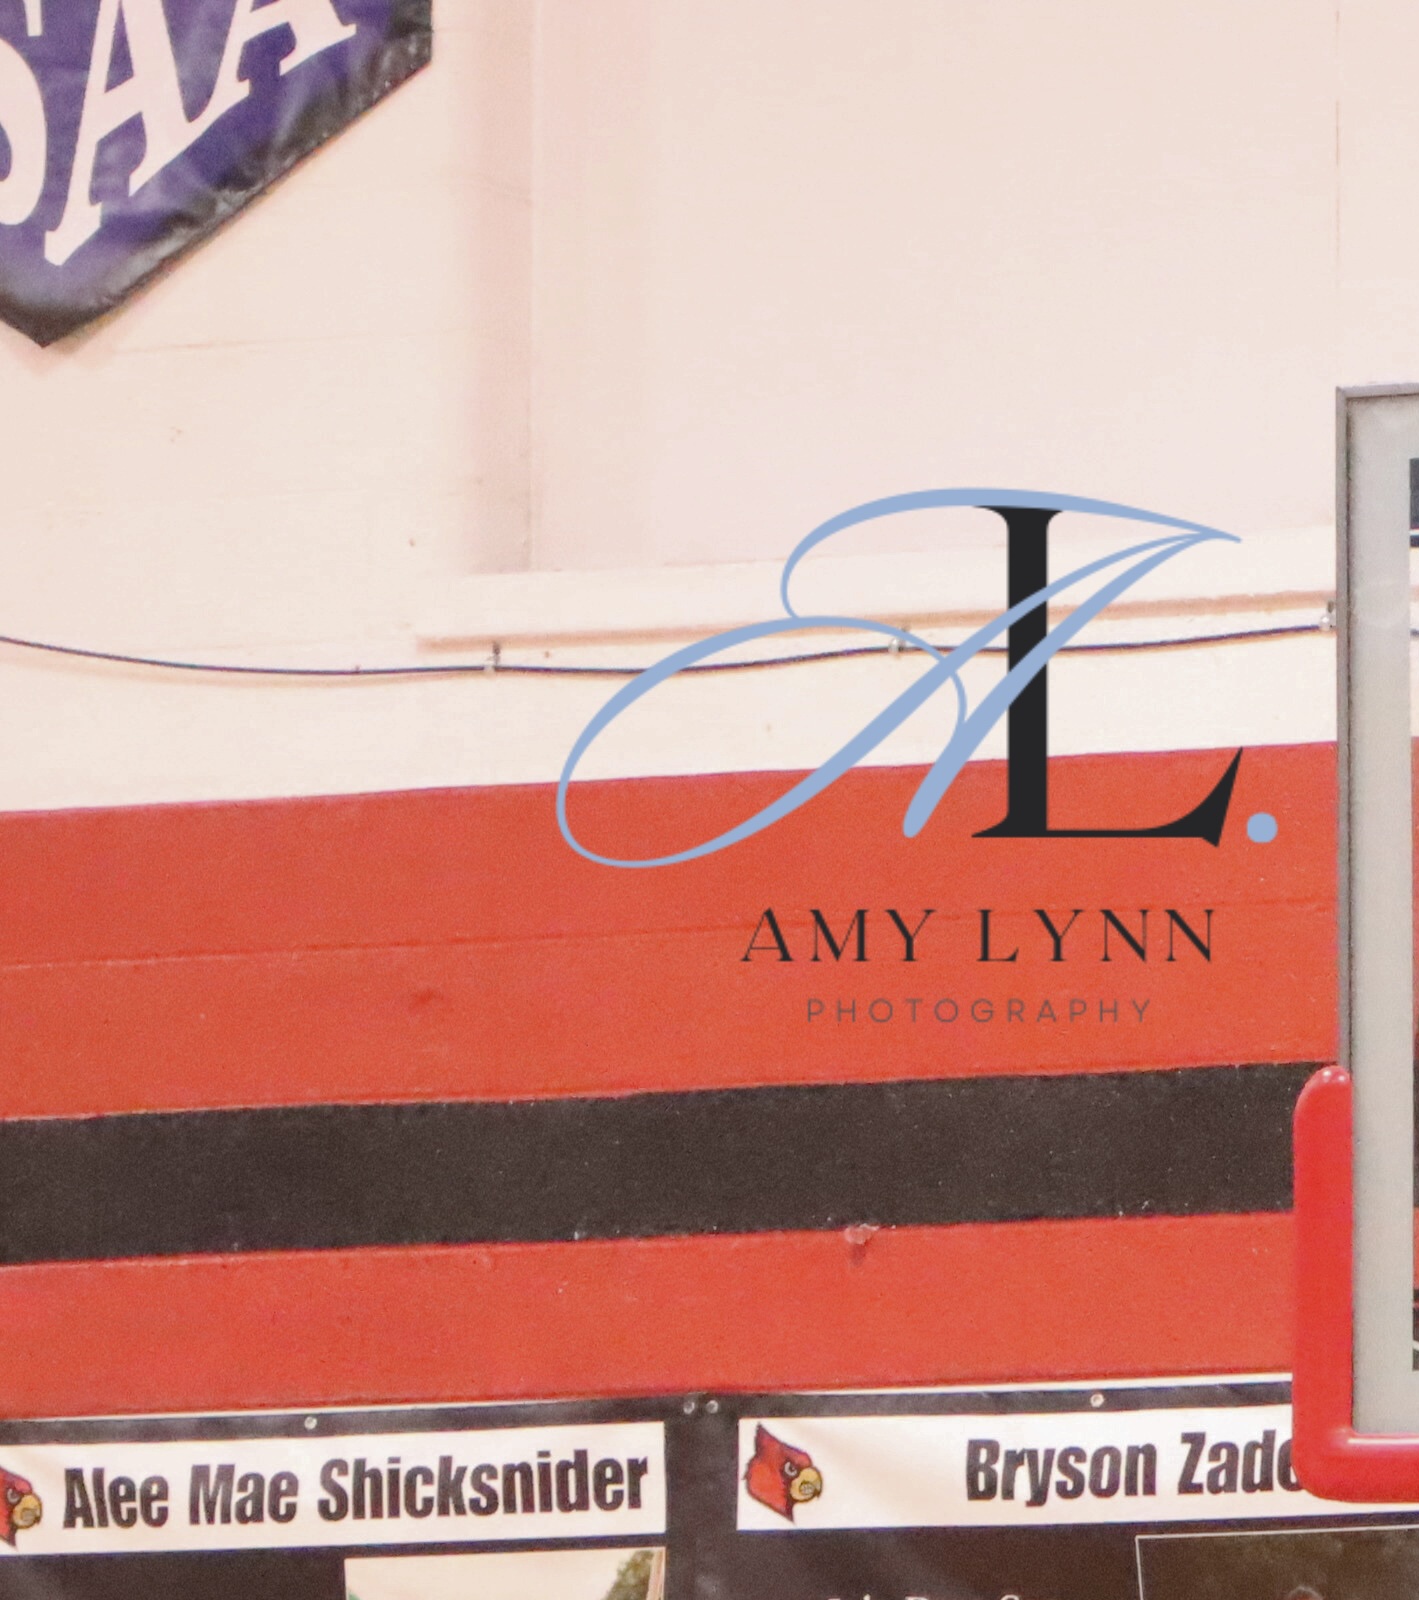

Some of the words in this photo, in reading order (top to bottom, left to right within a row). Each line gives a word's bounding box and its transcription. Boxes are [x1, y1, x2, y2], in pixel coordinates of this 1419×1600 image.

[63, 1468, 168, 1528] Alee
[189, 1465, 298, 1525] Mae
[318, 1450, 648, 1522] Shicksnider
[966, 1440, 1157, 1507] Bryson
